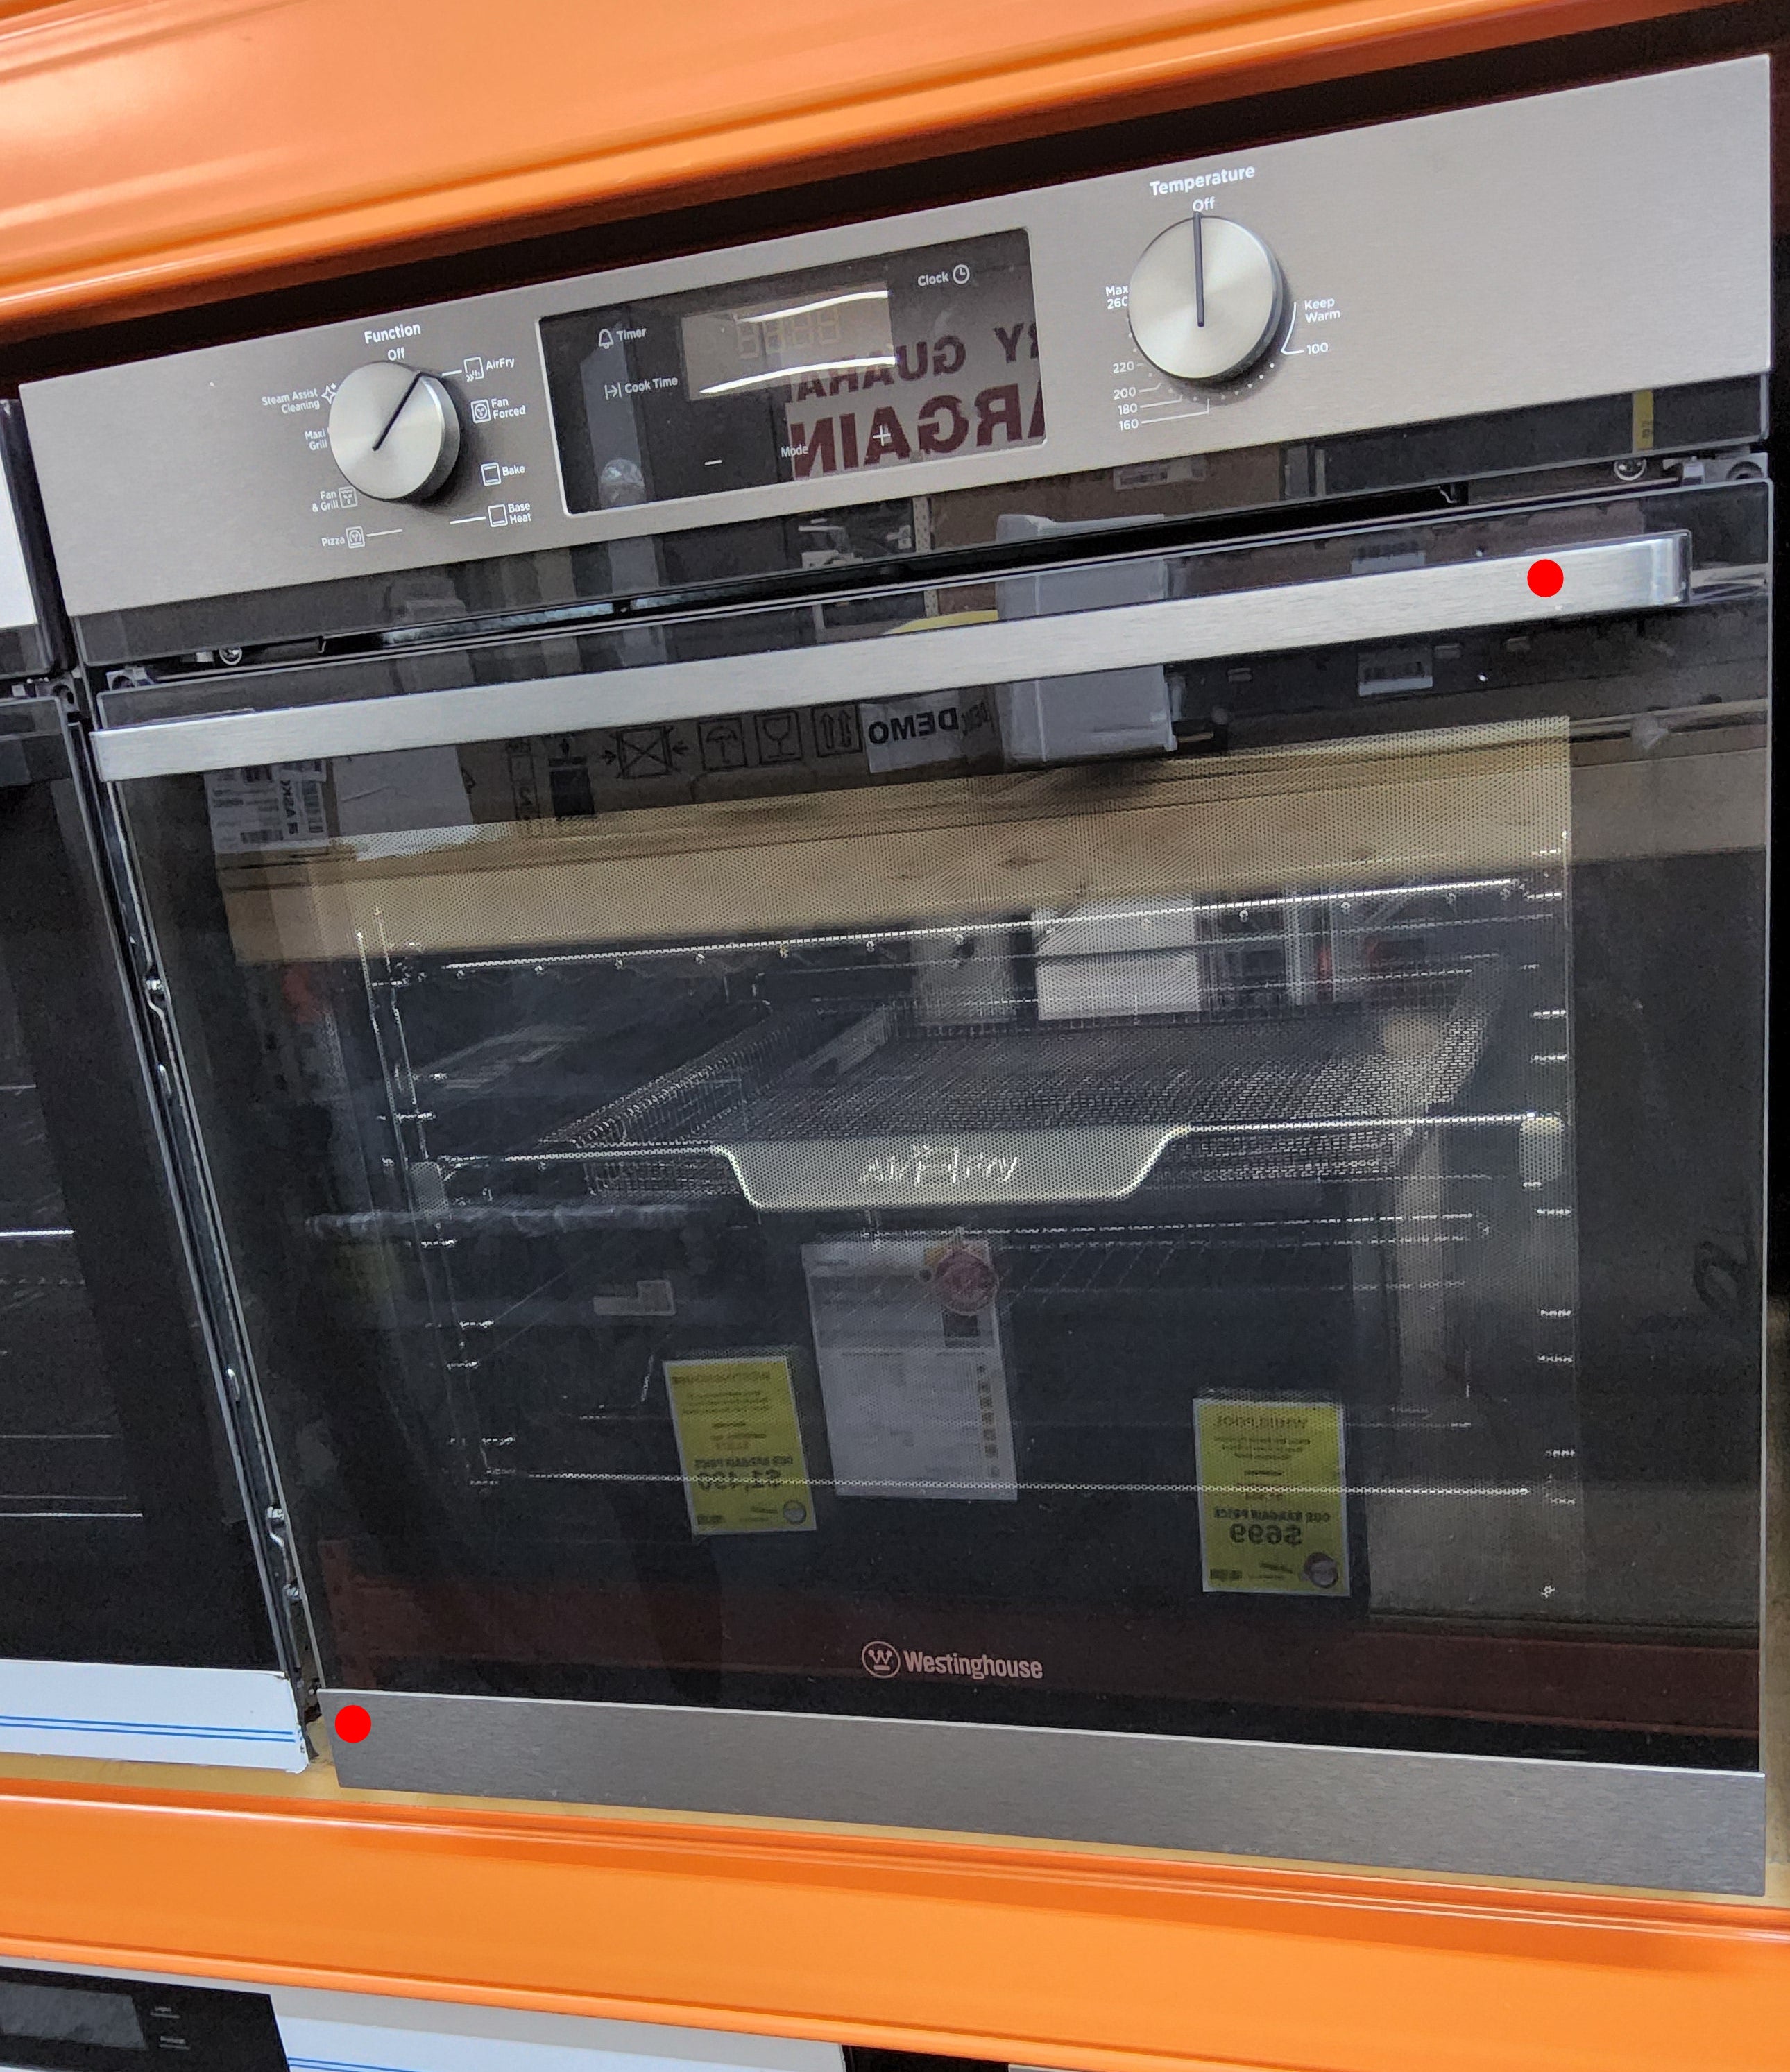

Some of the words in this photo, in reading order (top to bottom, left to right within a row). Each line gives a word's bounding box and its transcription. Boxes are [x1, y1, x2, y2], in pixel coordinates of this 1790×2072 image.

[1149, 165, 1256, 196] Temperature
[1192, 196, 1216, 212] Off
[917, 271, 950, 286] Clock
[1105, 284, 1129, 297] Max
[1304, 297, 1336, 311] Keep
[1304, 309, 1341, 323] Warm
[364, 323, 422, 344] Function
[617, 326, 647, 342] Timer
[387, 347, 406, 361] Off
[1306, 342, 1329, 354] 100
[486, 357, 515, 371] AirFry
[1113, 361, 1135, 374] 220
[624, 379, 651, 394] Cook
[652, 375, 679, 391] Time
[262, 391, 291, 407] Steam
[291, 388, 318, 402] Assist
[1114, 386, 1136, 400] 200
[281, 399, 321, 415] Cleaning
[491, 397, 509, 409] Fan
[1118, 402, 1138, 416] 180
[492, 405, 526, 420] Forced
[1119, 419, 1139, 431] 160
[304, 429, 326, 441] Maxi
[309, 438, 328, 451] Grill
[780, 443, 810, 459] Mode
[502, 464, 526, 477] Bake
[320, 489, 337, 500] Fan
[312, 502, 319, 513] &
[320, 499, 339, 511] Grill
[507, 502, 531, 513] Base
[509, 512, 532, 524] Heat
[321, 535, 346, 548] Pizza
[903, 1650, 1043, 1680] Westinghouse
